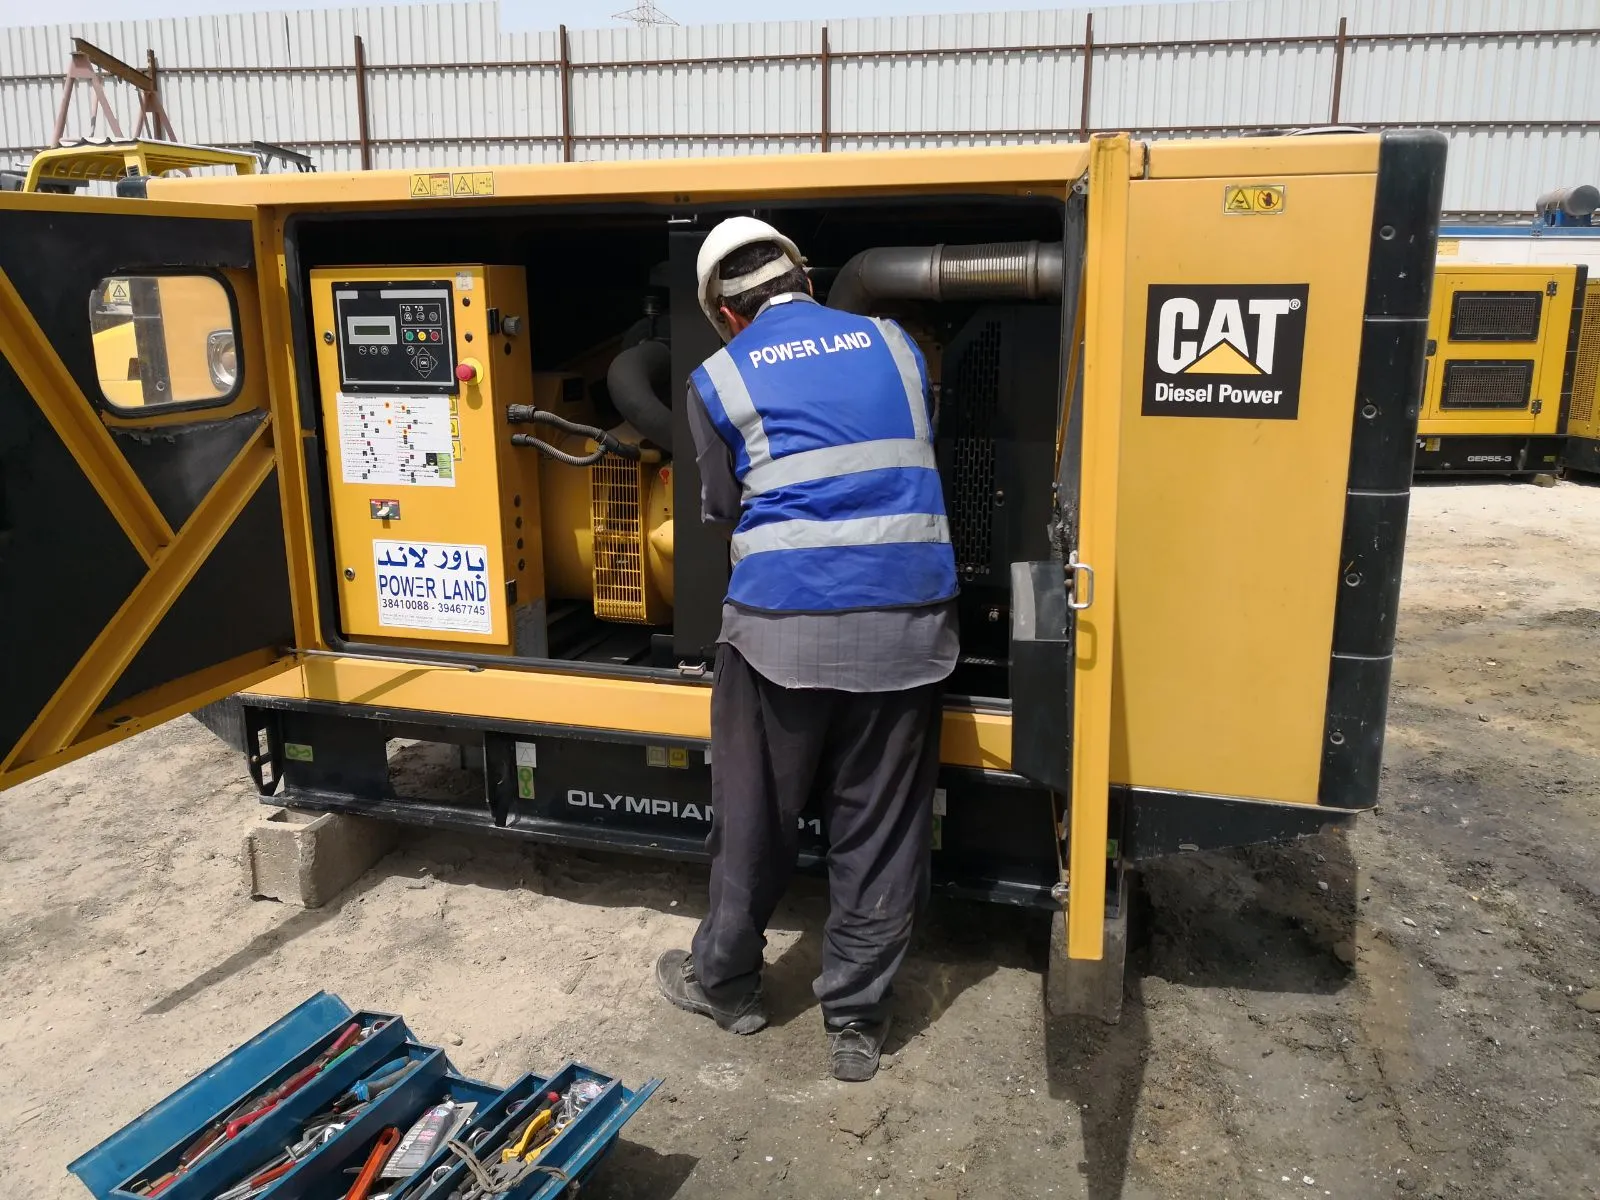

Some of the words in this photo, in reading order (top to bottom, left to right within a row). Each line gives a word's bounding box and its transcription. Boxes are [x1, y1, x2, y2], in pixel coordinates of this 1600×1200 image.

[749, 340, 819, 368] POWER
[820, 332, 871, 353] LAND
[1155, 382, 1212, 404] Diesel
[1218, 384, 1283, 405] Power
[377, 546, 429, 569] لاند
[434, 549, 485, 580] باور
[379, 575, 437, 599] POWER
[442, 579, 487, 602] LAND
[382, 598, 429, 611] 38410088
[438, 602, 485, 616] 39467745
